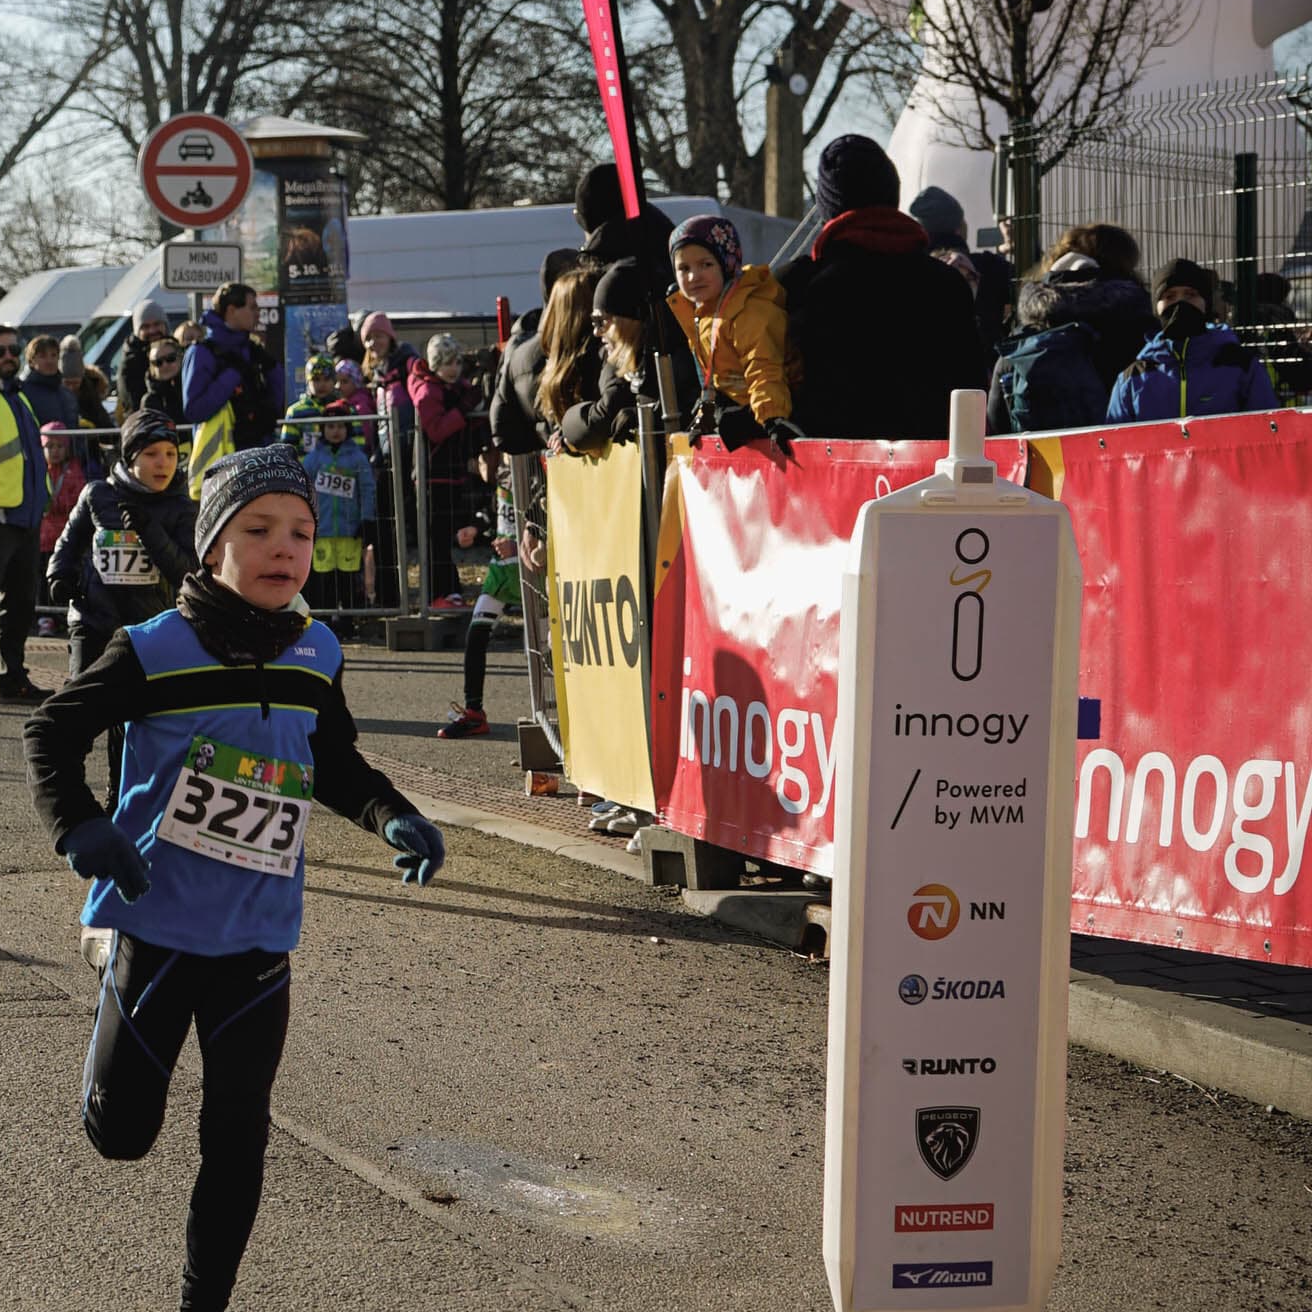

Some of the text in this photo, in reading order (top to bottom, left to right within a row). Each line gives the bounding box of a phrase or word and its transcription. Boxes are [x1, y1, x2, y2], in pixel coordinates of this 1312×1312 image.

[189, 251, 218, 264] MIMO
[317, 473, 352, 492] 3196
[100, 550, 153, 573] 3173
[894, 703, 1030, 744] innogy
[680, 656, 839, 818] innogy
[936, 778, 1027, 799] Powered
[173, 775, 301, 851] 3273
[934, 805, 1024, 830] by MVM
[1074, 748, 1312, 896] nnogy
[969, 901, 1006, 920] NN
[931, 976, 1006, 1001] ŠKODA
[921, 1057, 997, 1076] RUNTO
[921, 1113, 975, 1121] PEUGEOT
[900, 1209, 990, 1228] NUTREND
